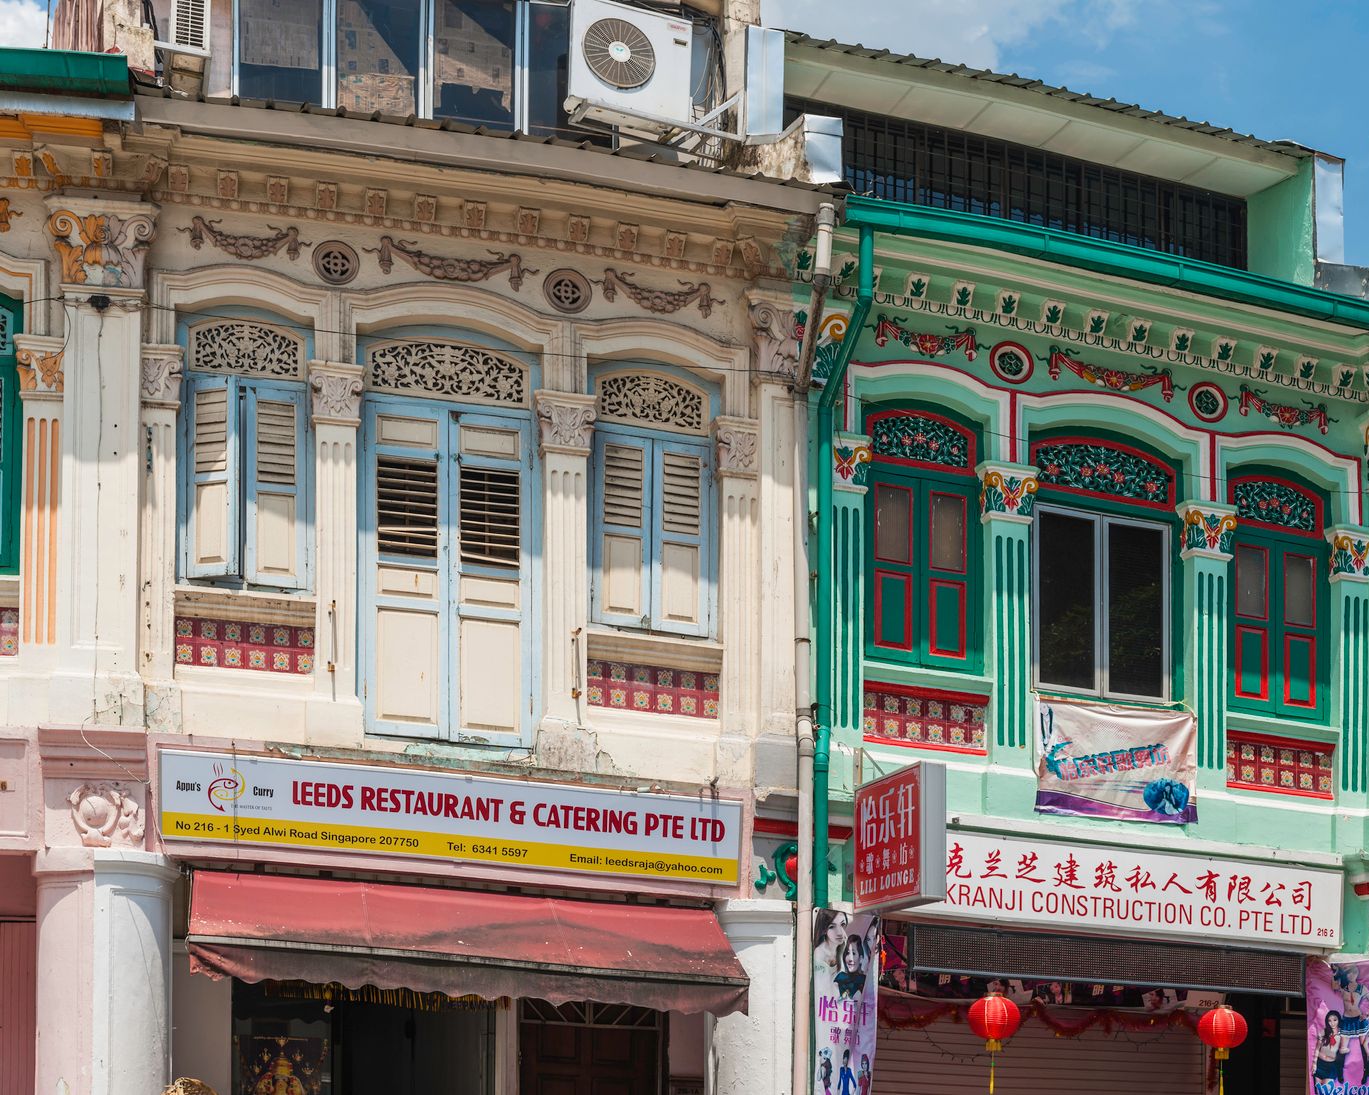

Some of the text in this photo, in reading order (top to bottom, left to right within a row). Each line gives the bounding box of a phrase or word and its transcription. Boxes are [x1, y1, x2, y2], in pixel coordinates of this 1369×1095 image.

[175, 779, 202, 793] Appu's
[253, 785, 274, 798] Curry
[292, 780, 726, 843] LEEDS RESTAURANT & CATERING PTE LTD
[860, 783, 915, 850] 怡乐轩
[175, 820, 191, 831] No
[193, 821, 214, 832] 216
[233, 824, 260, 838] Syed
[263, 827, 287, 838] Alwi
[289, 828, 317, 840] Road
[320, 831, 376, 846] Singapore
[379, 835, 419, 848] 207750
[447, 841, 528, 858] Tel: 6341 5597
[569, 853, 723, 875] Email: leedsraja@yahoo.com
[946, 842, 1313, 912] 克兰芝建筑私人有限公司
[860, 868, 914, 895] LILI LOUNGE
[944, 883, 1313, 936] KRANJI CONSTRUCTION CO. PTE LTD
[1317, 928, 1328, 937] 216
